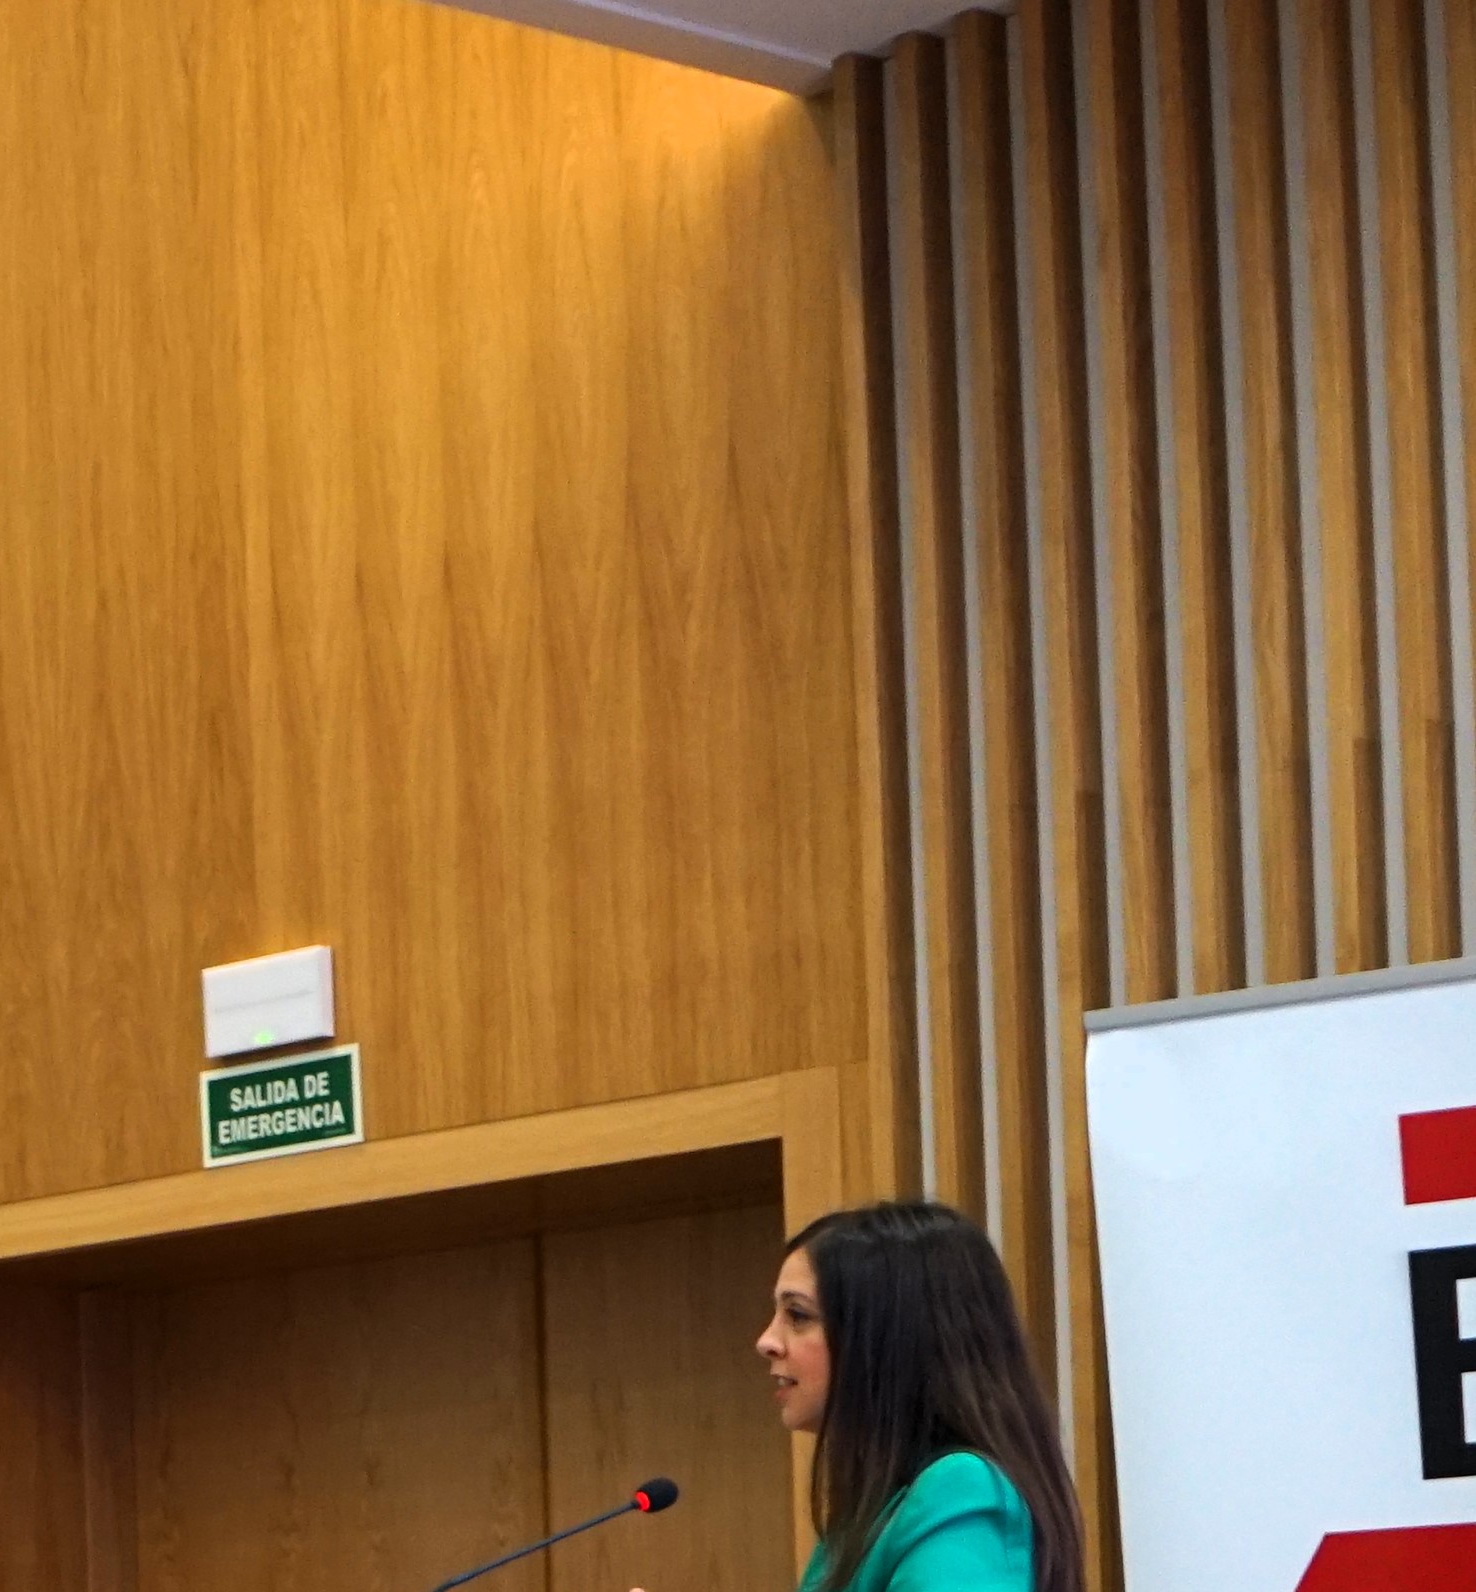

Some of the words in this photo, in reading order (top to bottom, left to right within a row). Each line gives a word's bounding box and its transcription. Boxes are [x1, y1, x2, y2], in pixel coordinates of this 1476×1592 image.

[230, 1077, 300, 1112] SALIDA
[303, 1071, 330, 1097] DE
[218, 1100, 346, 1145] EMERGENCIA
